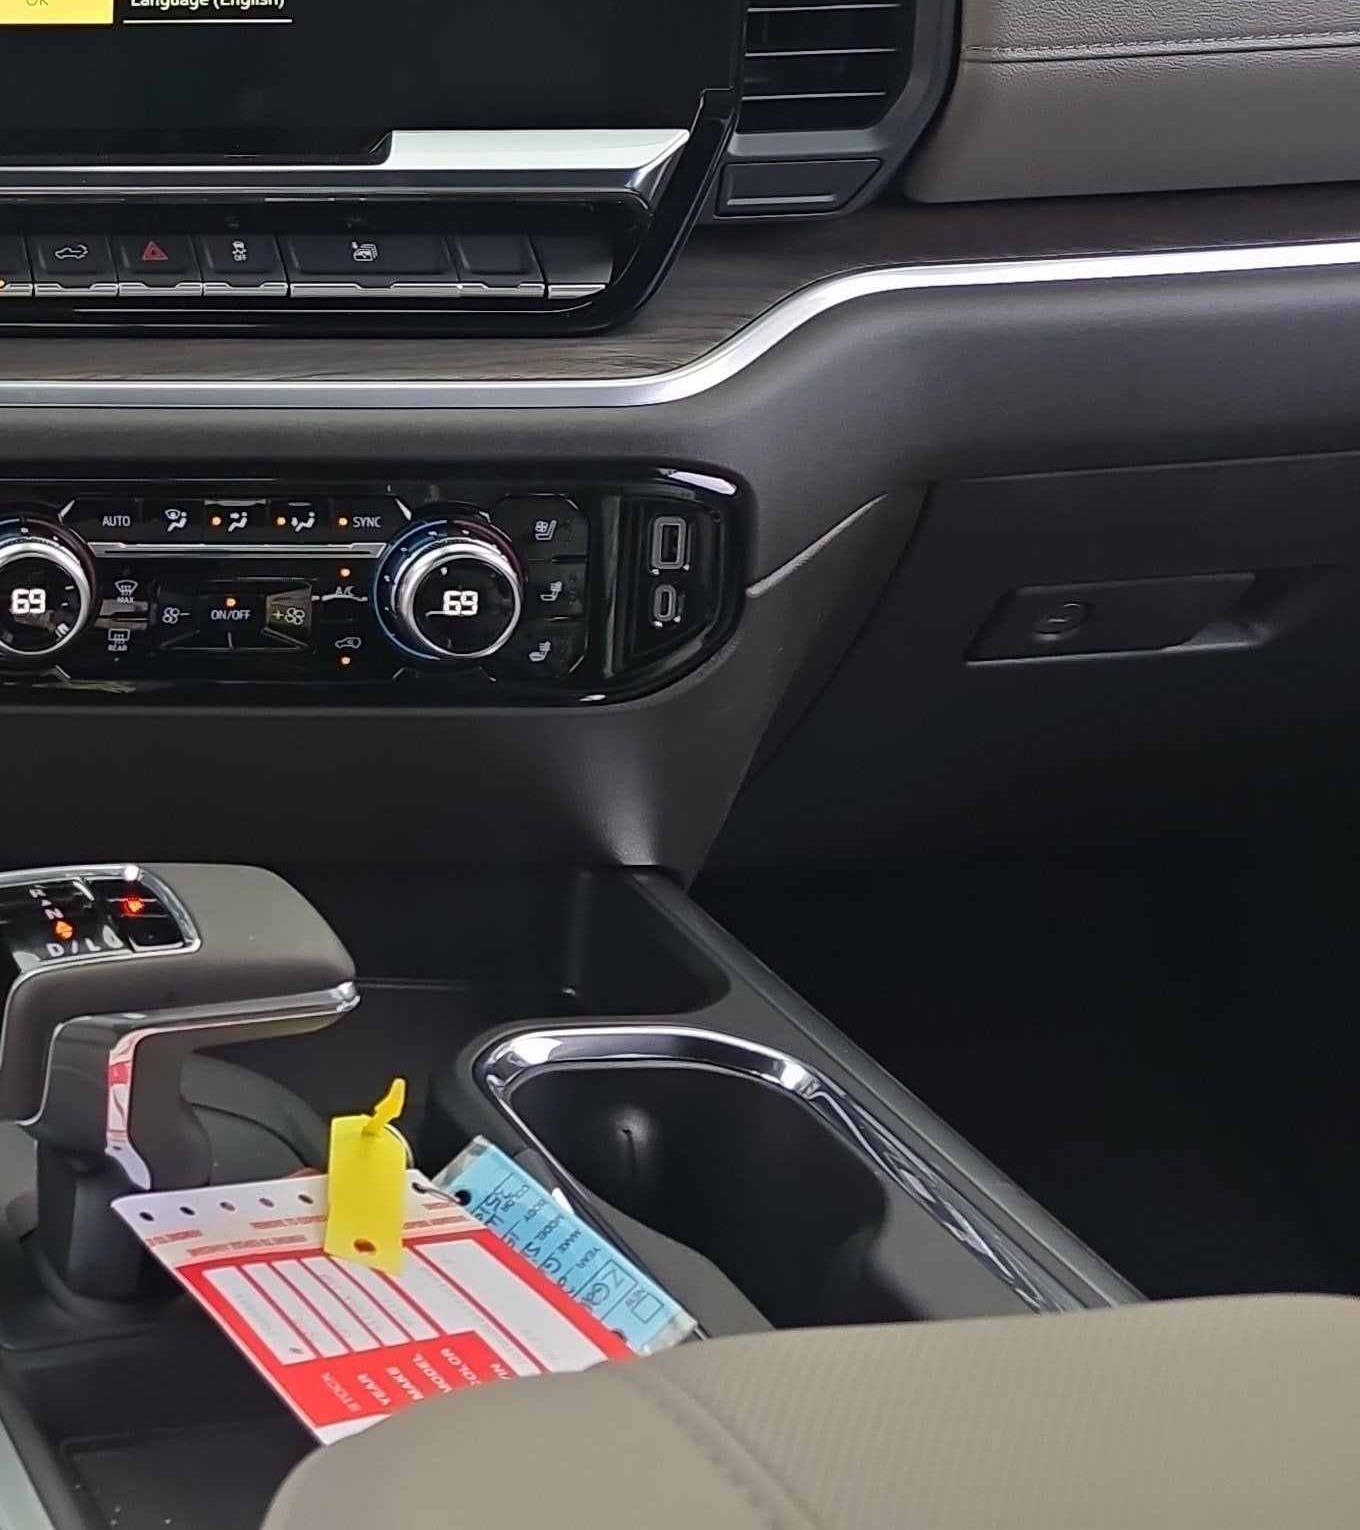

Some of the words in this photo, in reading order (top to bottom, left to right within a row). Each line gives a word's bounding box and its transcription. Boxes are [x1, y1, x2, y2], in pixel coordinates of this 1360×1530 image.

[101, 515, 131, 528] AUTO
[352, 516, 382, 529] SYNC
[11, 588, 46, 615] 69
[442, 590, 478, 616] 69
[210, 609, 252, 621] ON/OFF
[557, 1229, 583, 1255] MAKE
[575, 1247, 601, 1270] YEAR
[320, 1372, 362, 1412] STOCK
[357, 1372, 391, 1406] YEAR
[385, 1366, 424, 1400] MAKE
